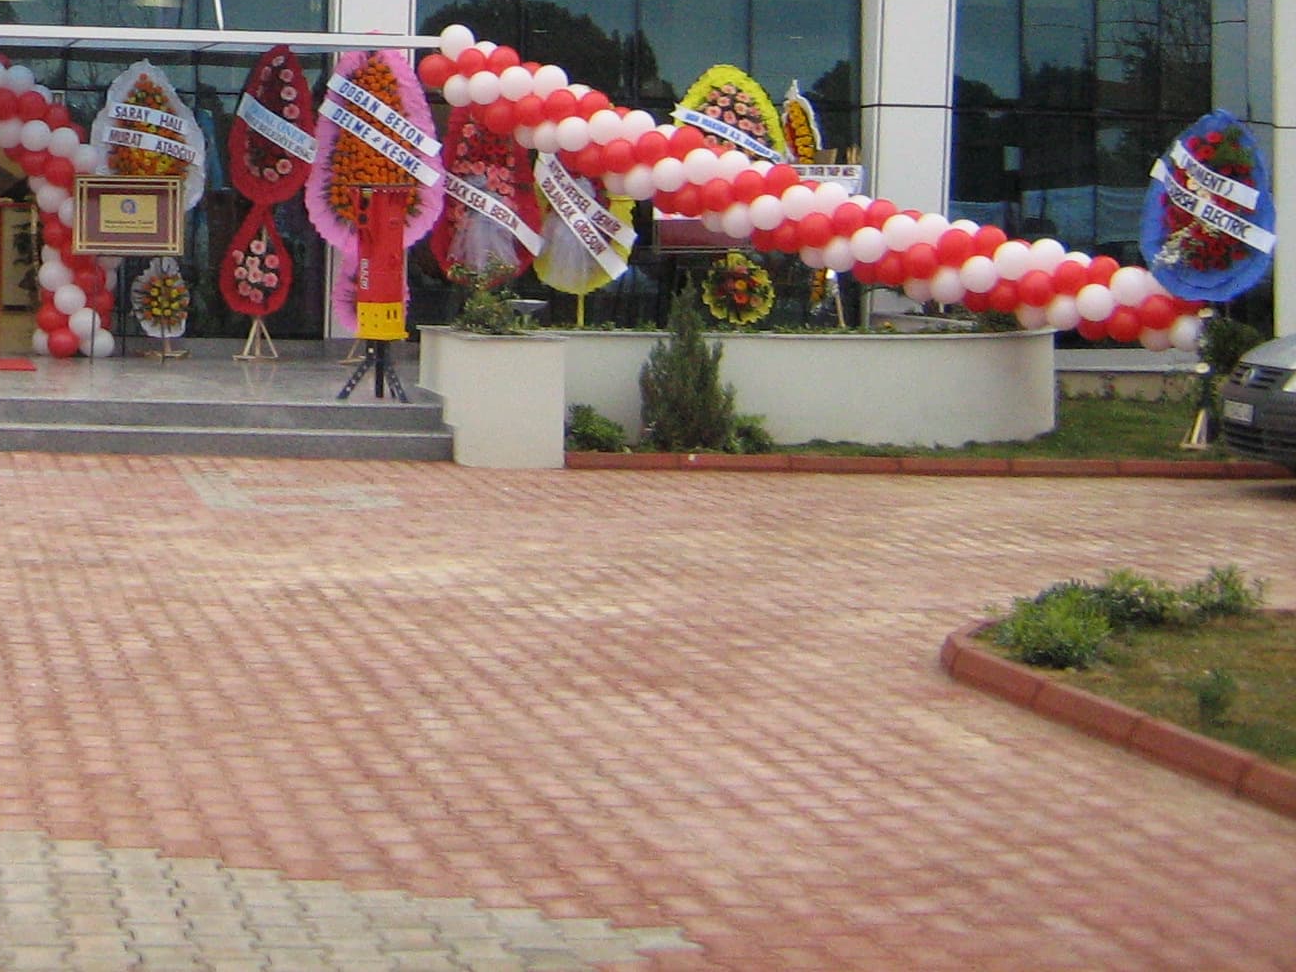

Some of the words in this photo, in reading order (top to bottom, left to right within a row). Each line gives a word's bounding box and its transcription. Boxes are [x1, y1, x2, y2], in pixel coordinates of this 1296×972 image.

[332, 108, 372, 139] DELME
[381, 140, 422, 174] KESME
[384, 112, 425, 146] BETON
[1201, 204, 1252, 239] ELECTRIC
